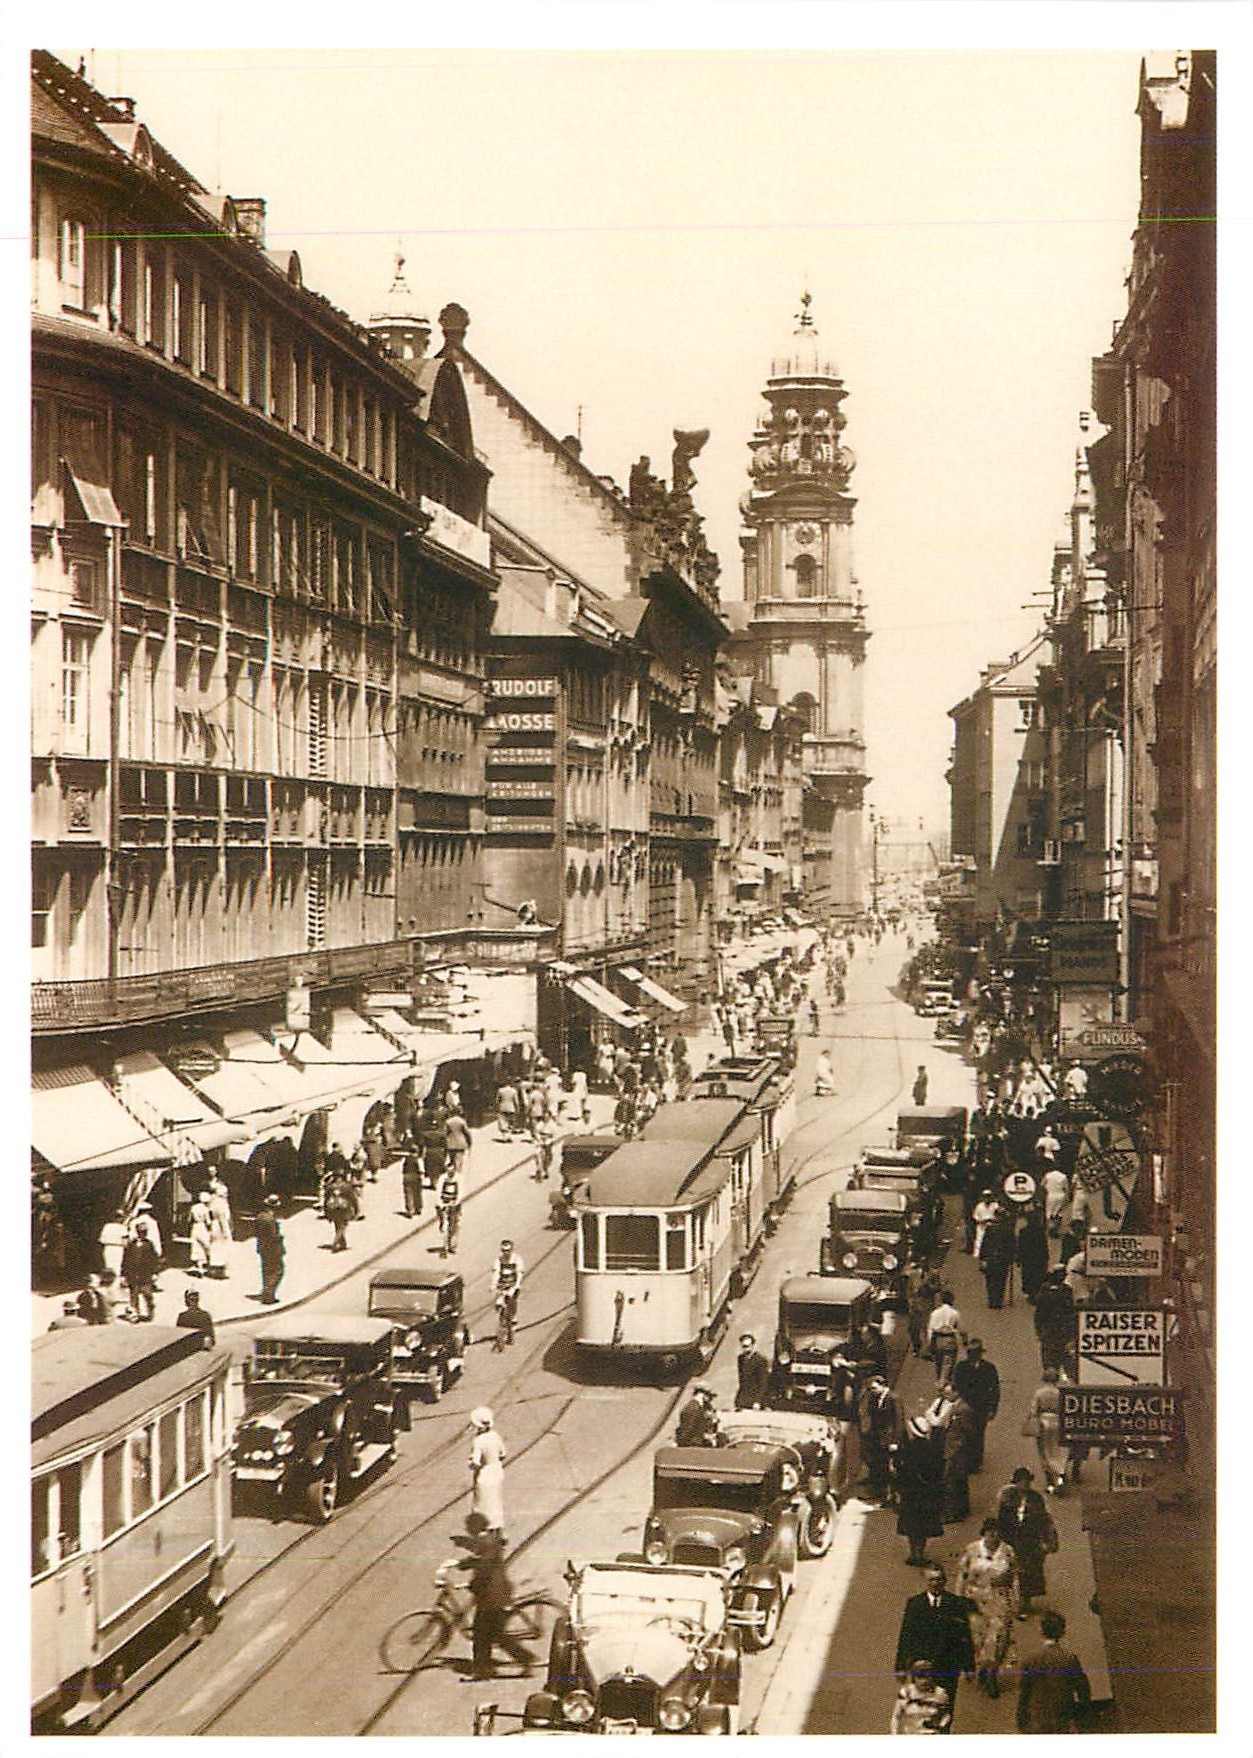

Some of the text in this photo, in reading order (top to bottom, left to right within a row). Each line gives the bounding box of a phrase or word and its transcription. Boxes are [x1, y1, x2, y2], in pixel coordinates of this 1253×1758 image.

[1085, 1313, 1157, 1331] RAISER
[1080, 1333, 1161, 1351] SPITZEN
[1064, 1394, 1175, 1415] DIESBACH
